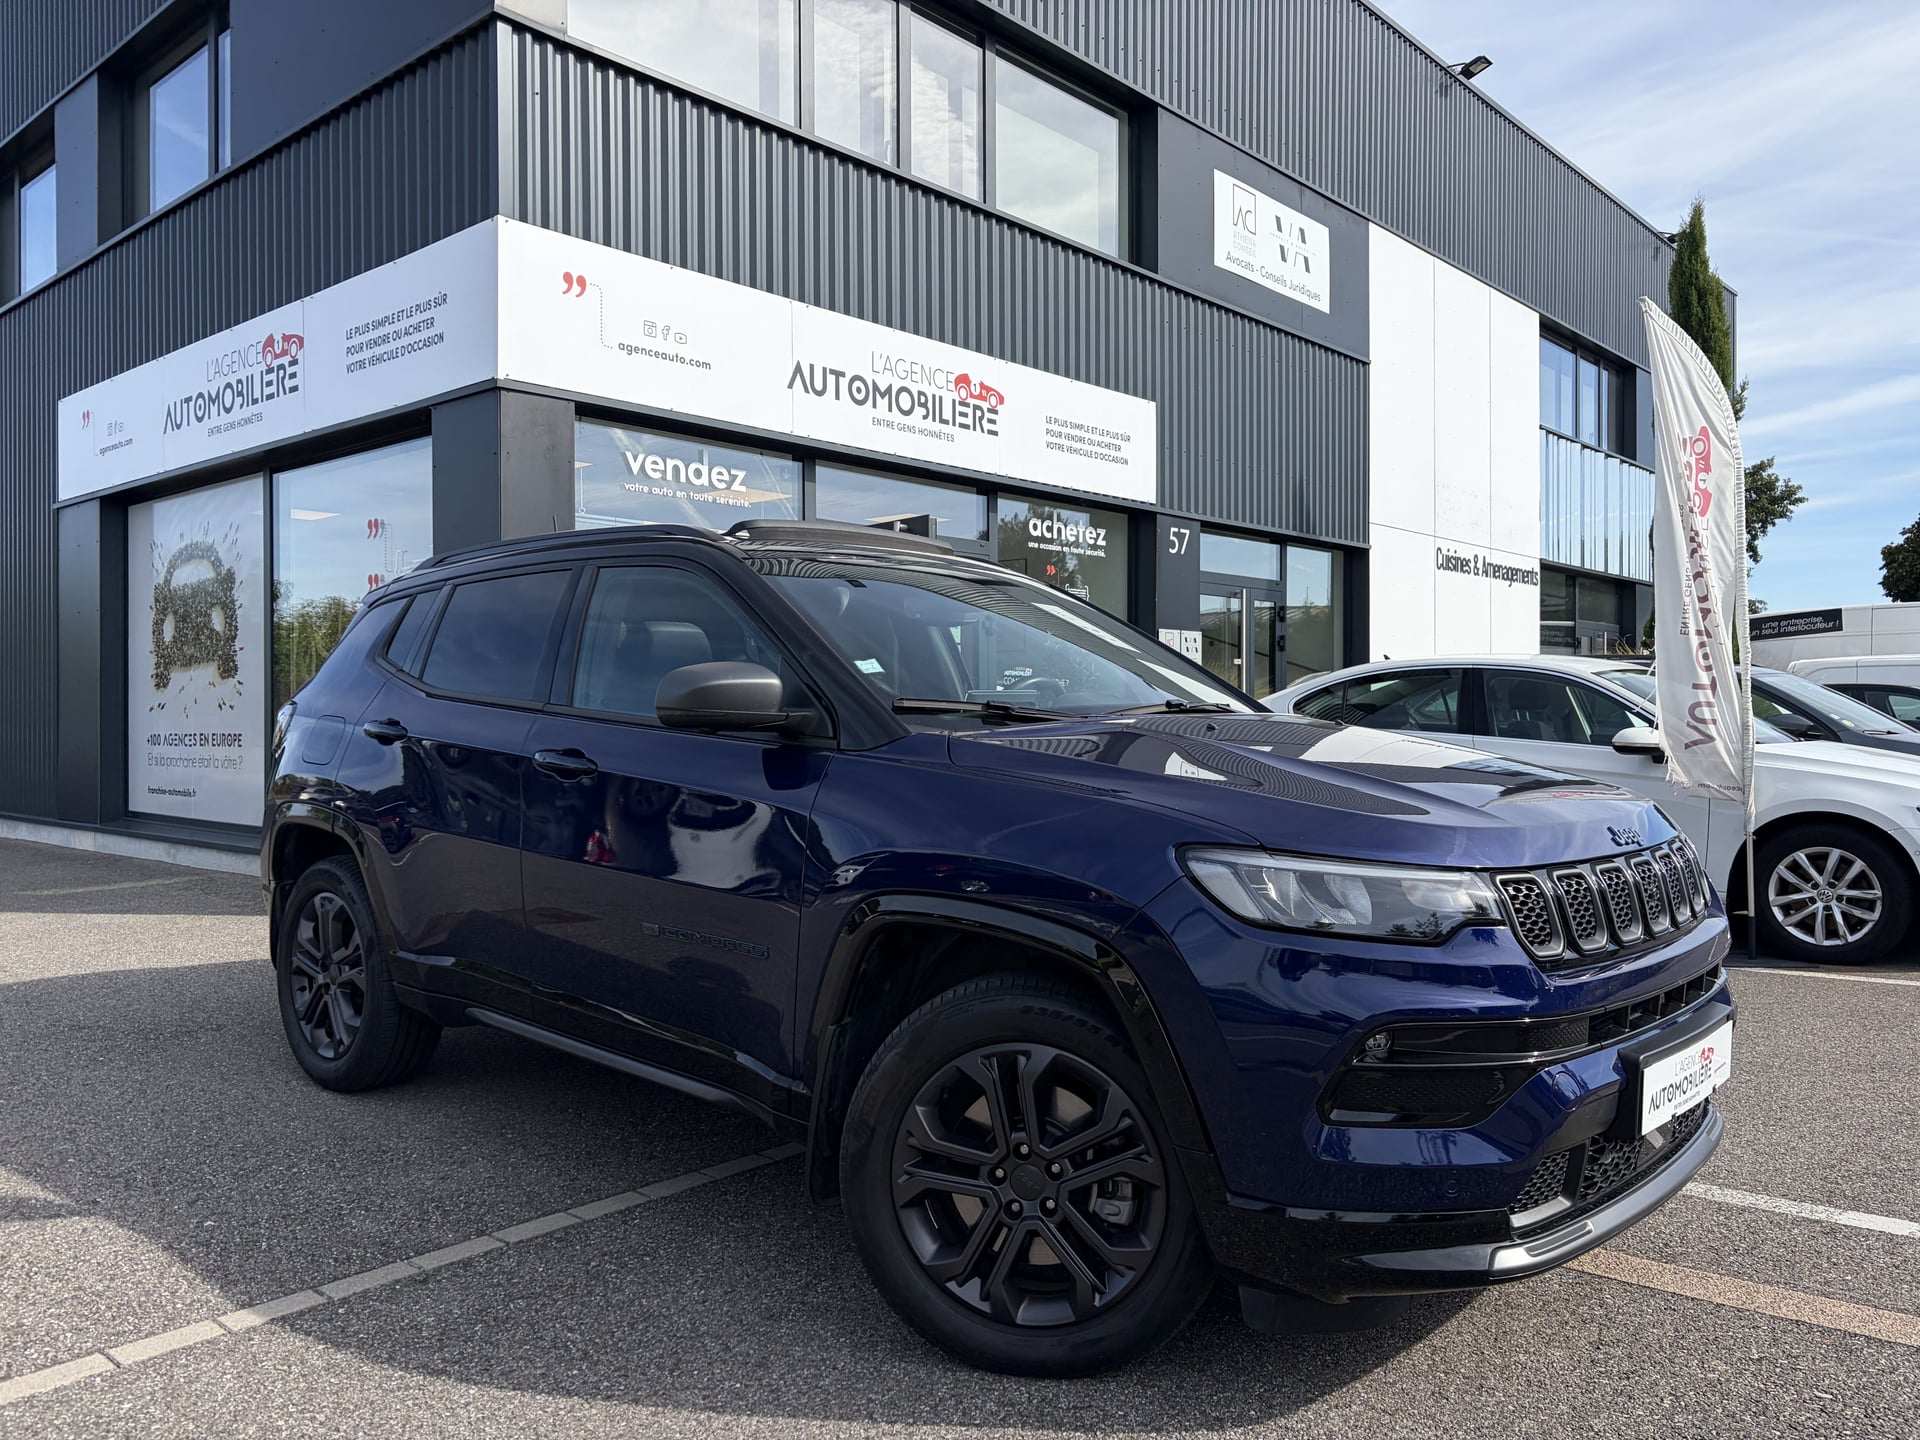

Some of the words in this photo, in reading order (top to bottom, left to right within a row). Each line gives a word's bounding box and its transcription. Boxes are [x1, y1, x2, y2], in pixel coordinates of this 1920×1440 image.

[1226, 251, 1254, 273] Avocats
[1260, 266, 1287, 288] Conseils
[1288, 280, 1321, 302] Juridiques
[346, 328, 353, 340] LE
[354, 322, 370, 338] PLUS
[371, 313, 395, 331] SIMPLE
[397, 309, 405, 322] ET
[406, 306, 414, 319] LE
[415, 299, 432, 315] PLUS
[346, 342, 364, 358] POUR
[365, 332, 390, 351] VENDRE
[392, 328, 402, 341] OU
[403, 316, 435, 338] ACHETER
[207, 341, 262, 382] L'AGENCE
[346, 358, 367, 374] VOTRE
[367, 345, 400, 367] VÉHICULE
[400, 331, 444, 357] D'OCCASION
[618, 342, 711, 370] agenceauto.com
[871, 351, 955, 392] L'AGENCE
[208, 425, 222, 437] ENTRE
[223, 421, 236, 432] GENS
[872, 417, 895, 430] ENTRE
[897, 422, 916, 435] GENS
[1045, 415, 1053, 425] LE
[1054, 417, 1068, 428] PLUS
[1069, 421, 1090, 434] SIMPLE
[1091, 427, 1098, 435] ET
[1098, 428, 1105, 437] LE
[1106, 430, 1119, 441] PLUS
[1045, 440, 1065, 453] VOTRE
[1094, 451, 1129, 466] D'OCCASION
[1046, 428, 1063, 440] POUR
[1063, 432, 1086, 445] VENDRE
[1087, 438, 1096, 447] OU
[1096, 440, 1122, 453] ACHETER
[625, 448, 747, 492] vendez
[624, 482, 649, 493] votre
[652, 485, 673, 497] auto
[676, 491, 687, 499] en
[690, 491, 713, 503] toute
[1028, 510, 1107, 546] achetez
[1169, 527, 1190, 555] 57
[1028, 541, 1039, 549] une
[1039, 543, 1062, 552] occasion
[1070, 546, 1084, 555] toute
[1436, 547, 1472, 575] Cuisines
[1473, 554, 1480, 576] &
[1481, 555, 1539, 587] Amenagements
[1761, 626, 1779, 635] seul
[1780, 621, 1834, 633] interlocuteur
[1762, 621, 1779, 629] une
[147, 734, 161, 746] +100
[163, 733, 197, 747] AGENCES
[199, 733, 209, 747] EN
[211, 733, 242, 748] EUROPE
[166, 753, 197, 770] prochaine
[212, 755, 219, 769] la
[1607, 826, 1644, 847] Jeep
